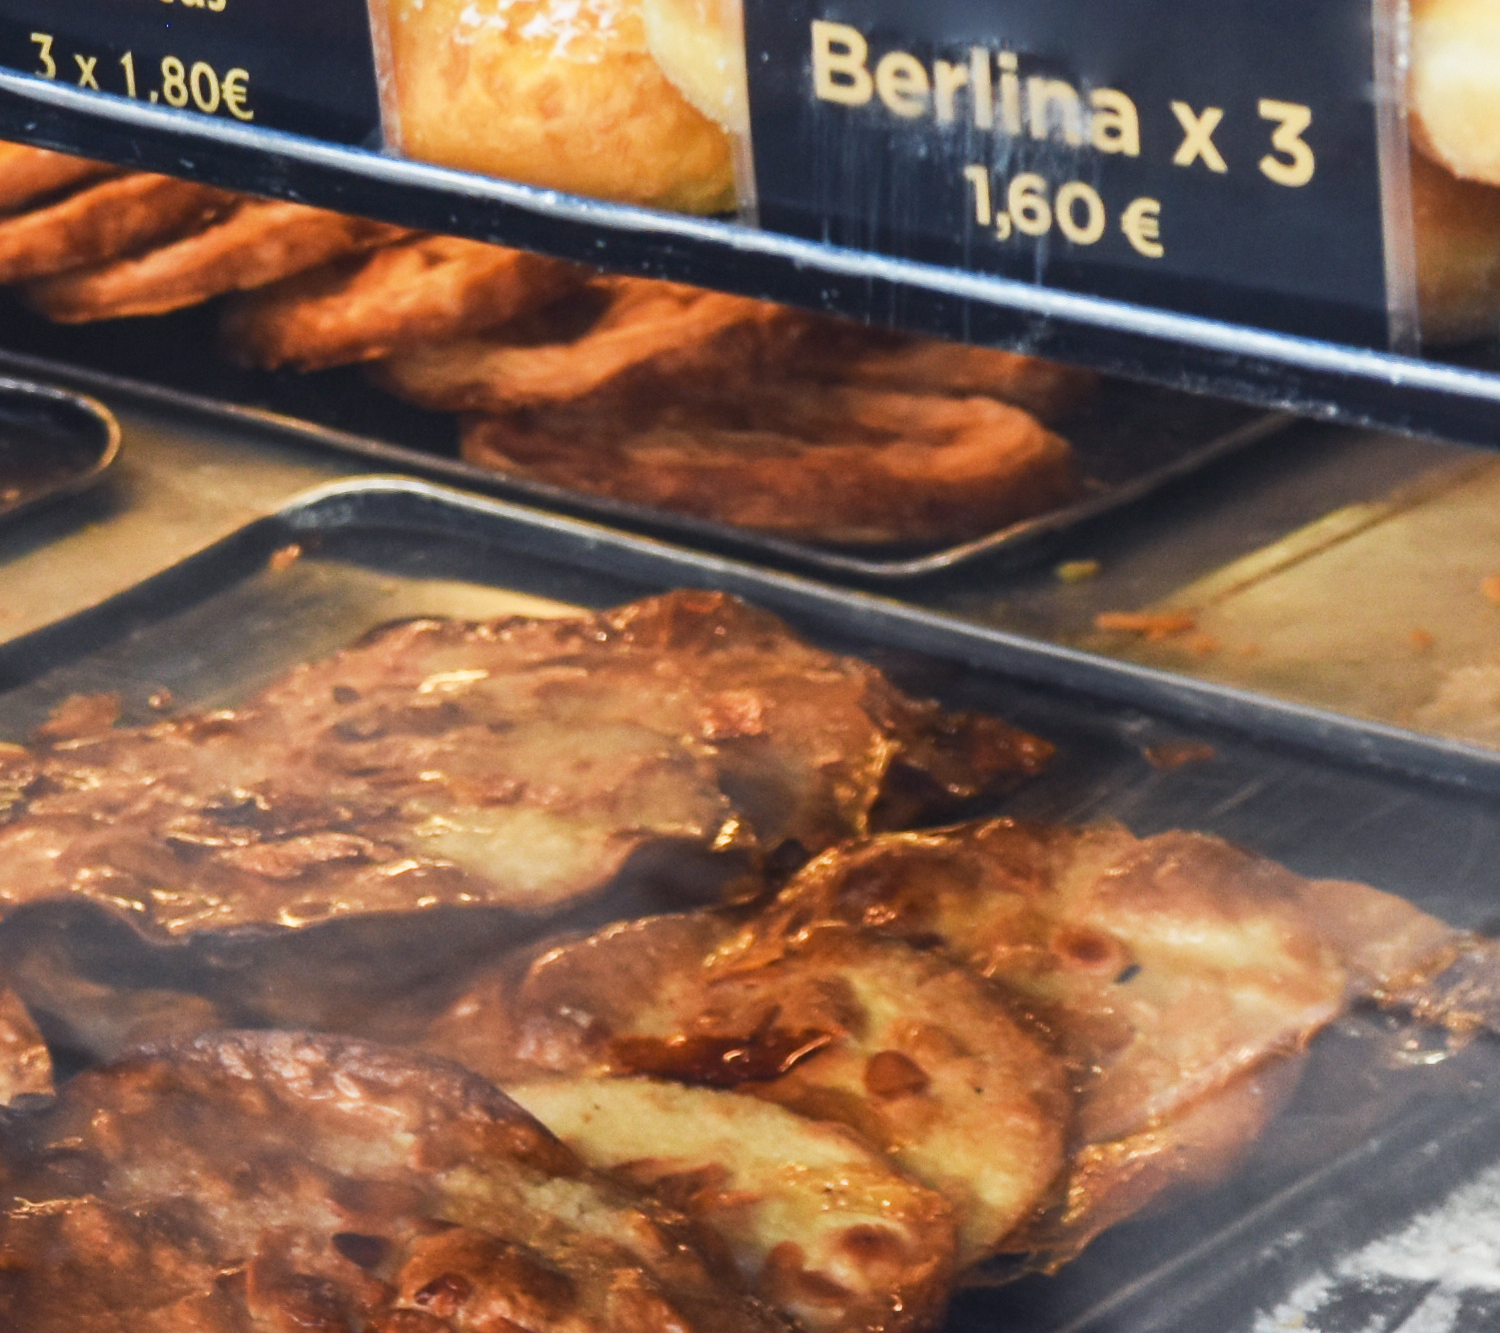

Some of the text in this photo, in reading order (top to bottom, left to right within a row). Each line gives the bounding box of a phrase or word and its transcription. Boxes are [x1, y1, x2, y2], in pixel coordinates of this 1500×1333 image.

[30, 32, 56, 80] 3
[74, 53, 99, 90] x
[811, 19, 1315, 186] Berlina x 3
